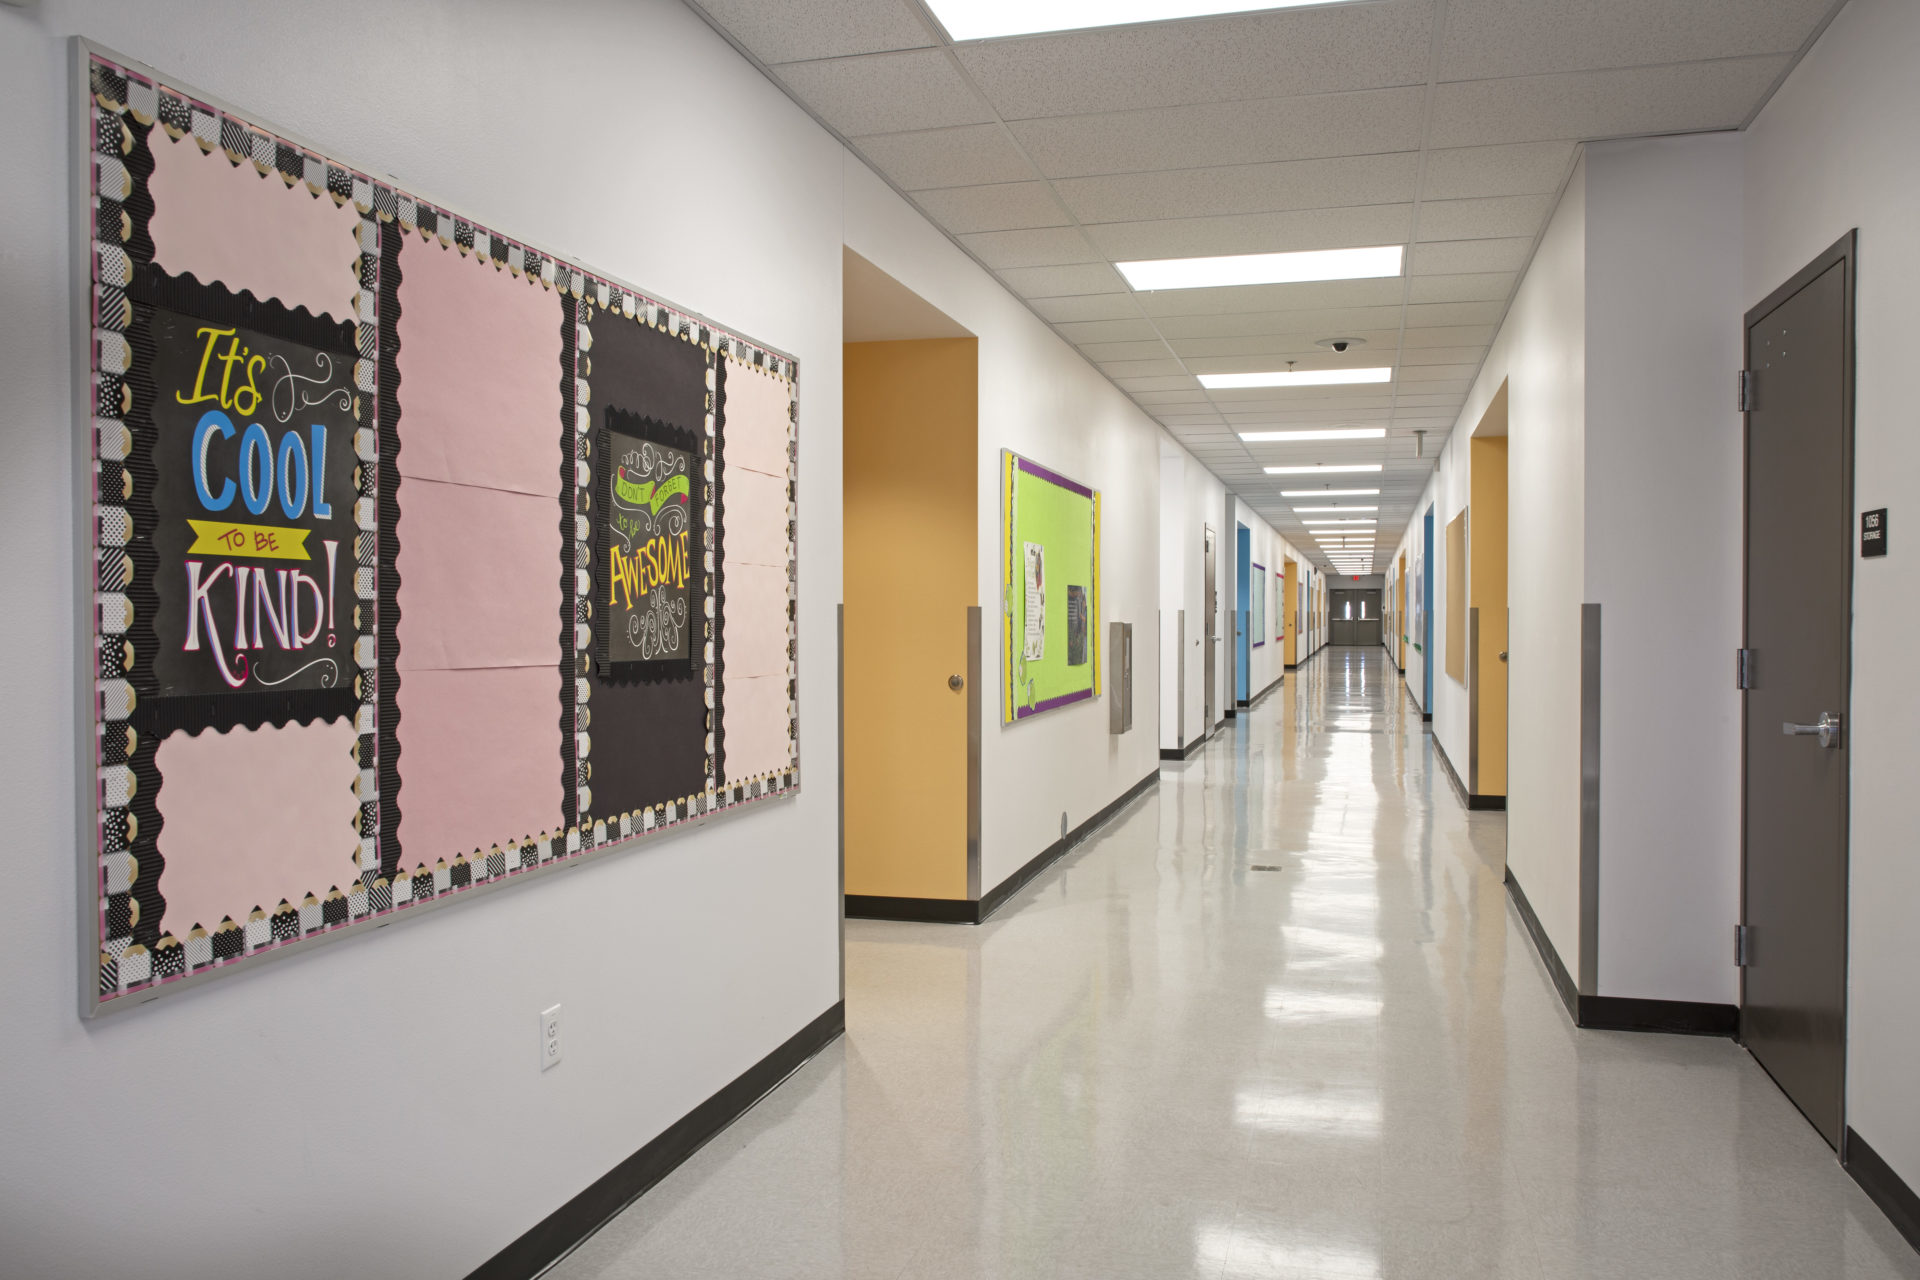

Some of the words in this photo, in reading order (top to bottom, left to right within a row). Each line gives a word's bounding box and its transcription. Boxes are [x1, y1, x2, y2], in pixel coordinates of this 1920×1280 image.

[176, 327, 266, 416] It's
[192, 410, 332, 520] COOL
[621, 481, 645, 502] DON'T
[654, 476, 682, 507] FORGET
[217, 528, 245, 552] TO
[253, 530, 280, 552] BE
[616, 512, 628, 531] to
[629, 519, 641, 539] be
[609, 530, 690, 611] AWESOME
[183, 540, 339, 688] KIND!
